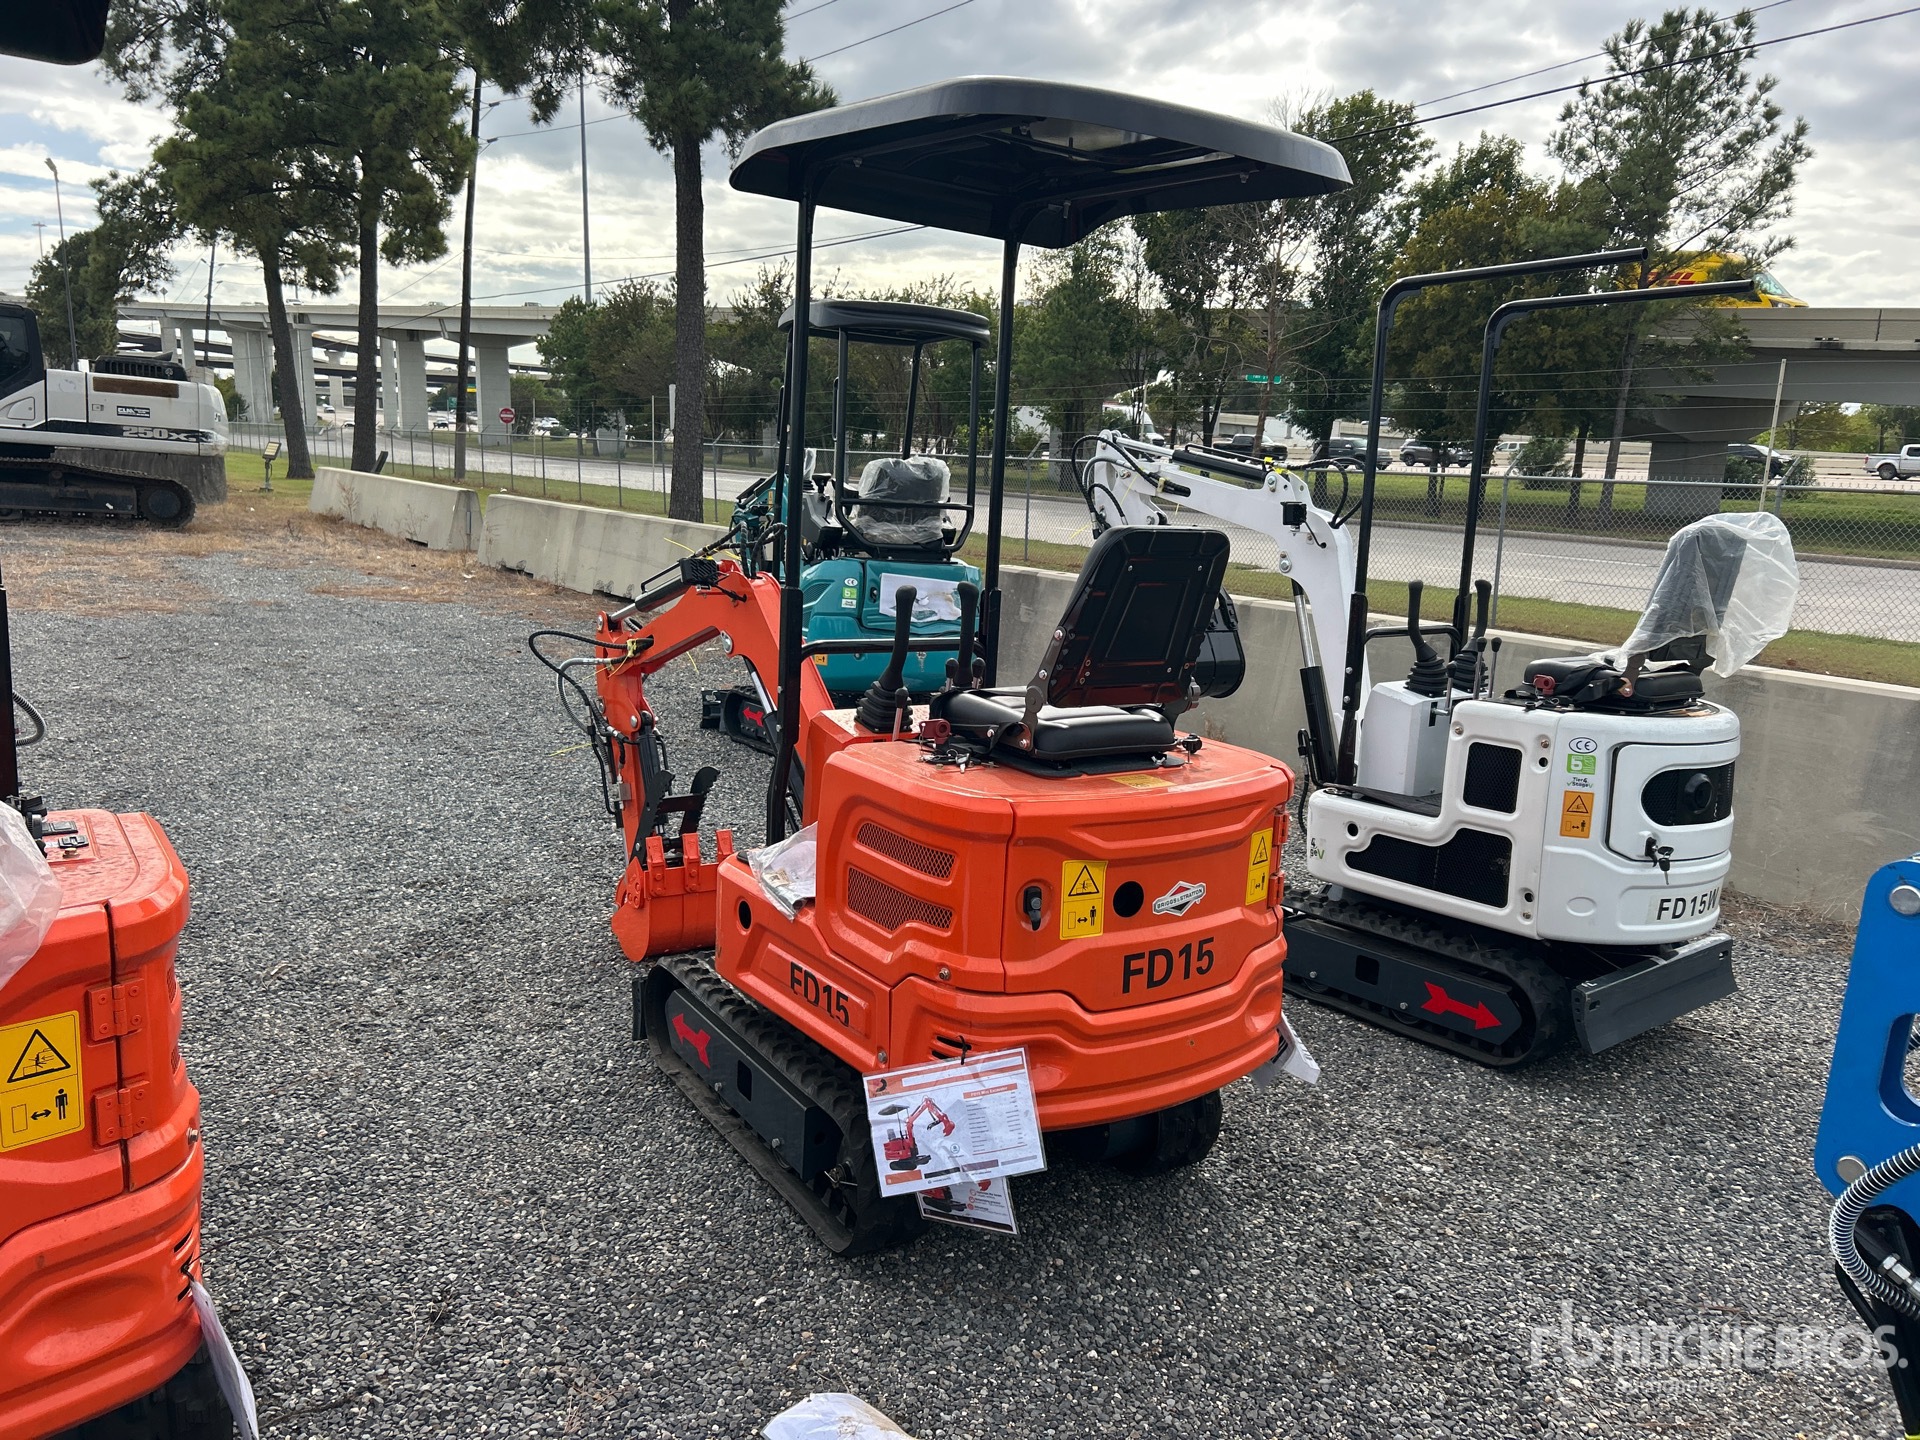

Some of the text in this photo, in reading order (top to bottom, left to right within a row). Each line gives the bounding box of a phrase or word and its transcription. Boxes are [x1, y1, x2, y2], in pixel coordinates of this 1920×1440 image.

[1576, 740, 1591, 751] CE
[790, 961, 850, 1028] FD15
[1122, 936, 1215, 995] FD15
